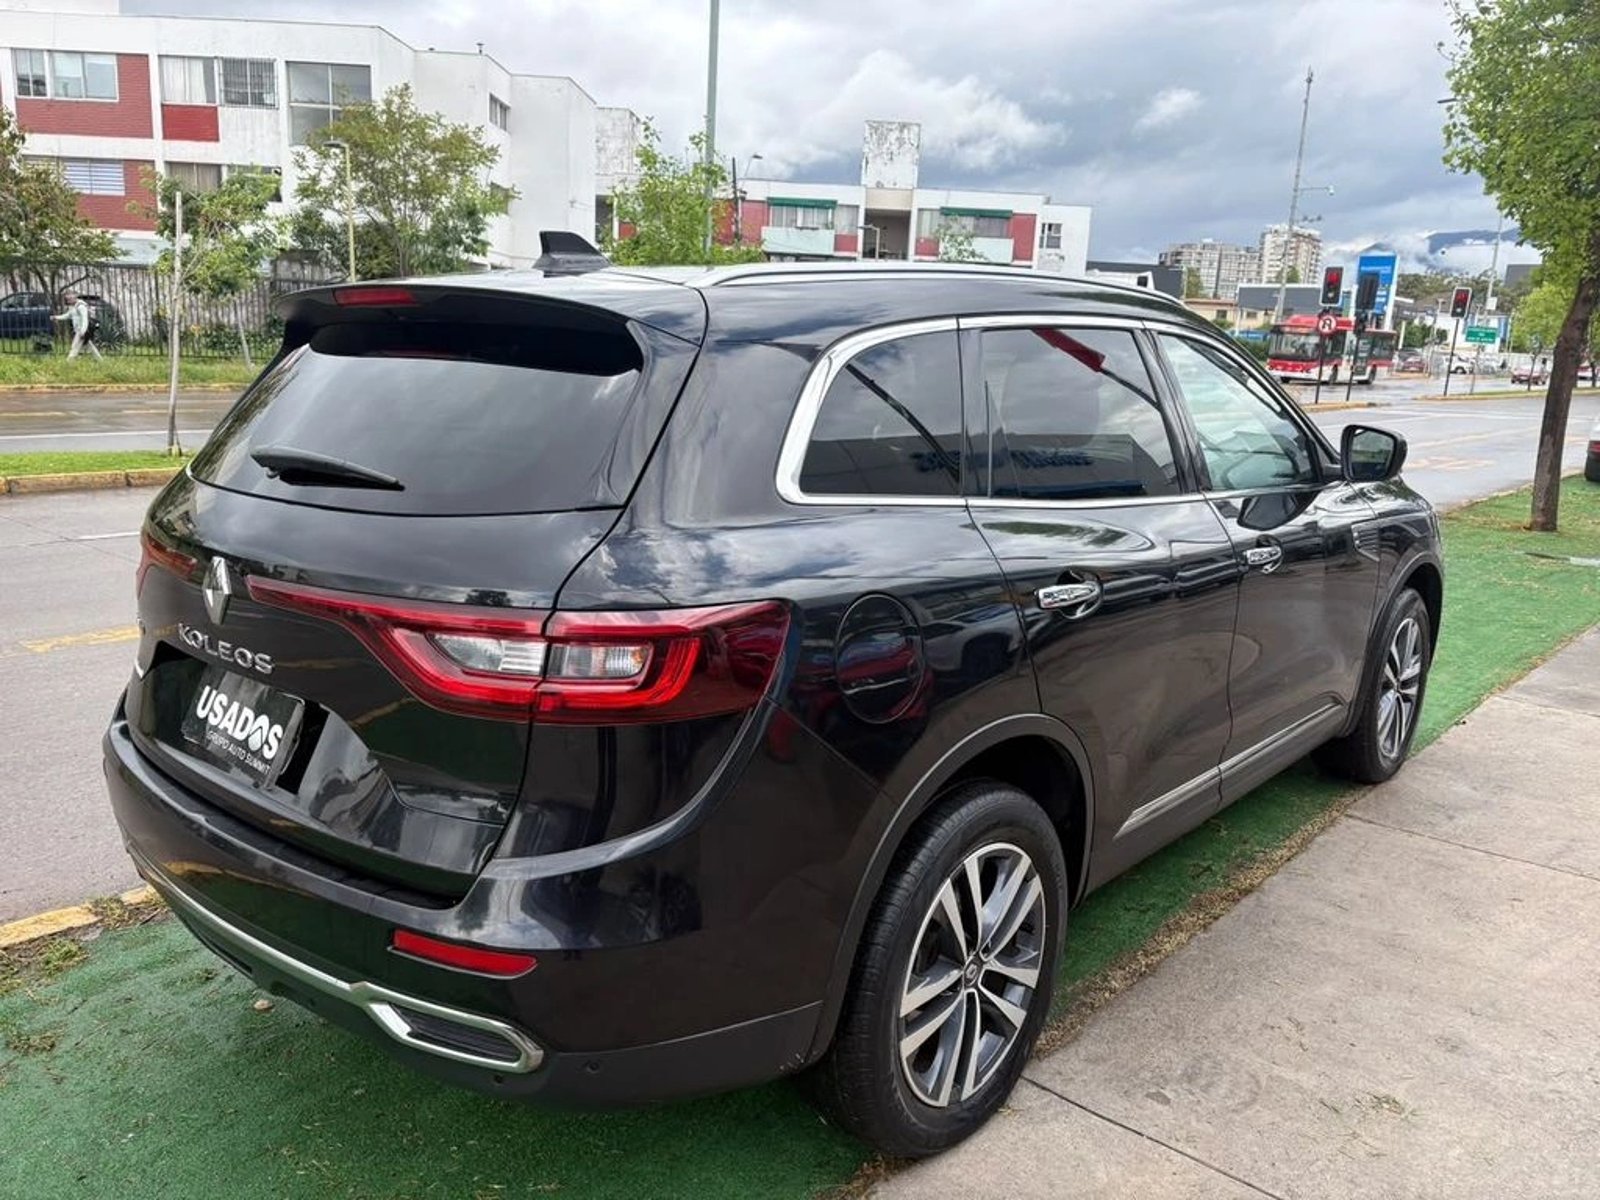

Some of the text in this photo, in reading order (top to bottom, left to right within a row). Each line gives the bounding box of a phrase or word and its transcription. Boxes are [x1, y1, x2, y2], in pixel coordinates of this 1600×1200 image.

[178, 623, 273, 674] KOLEOS
[197, 685, 283, 759] USADOS
[228, 743, 247, 761] AUTO
